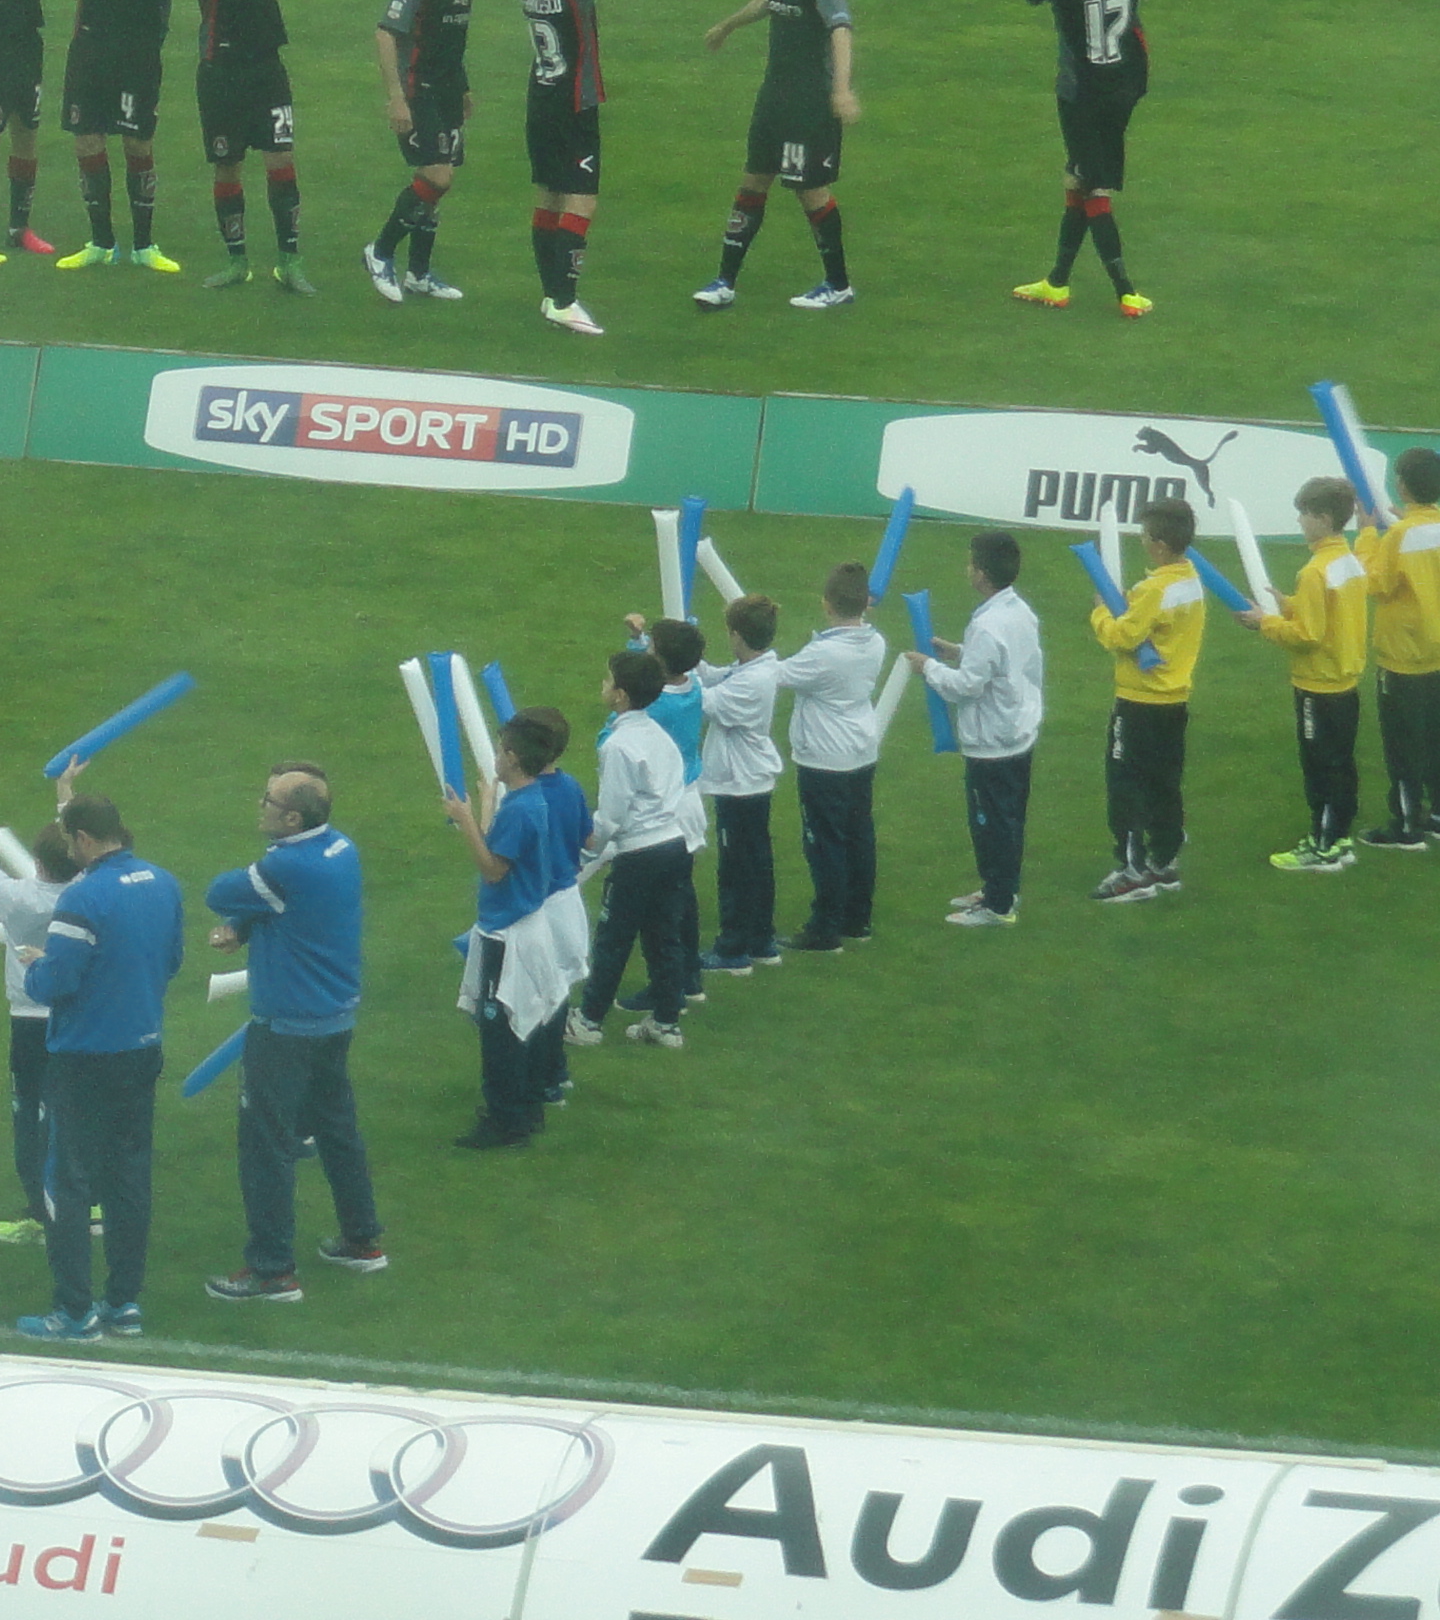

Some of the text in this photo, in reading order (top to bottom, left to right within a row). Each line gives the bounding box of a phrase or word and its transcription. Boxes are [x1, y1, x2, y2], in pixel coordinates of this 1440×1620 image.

[205, 389, 570, 456] sky SPORT HD
[640, 1443, 1225, 1611] Audi
